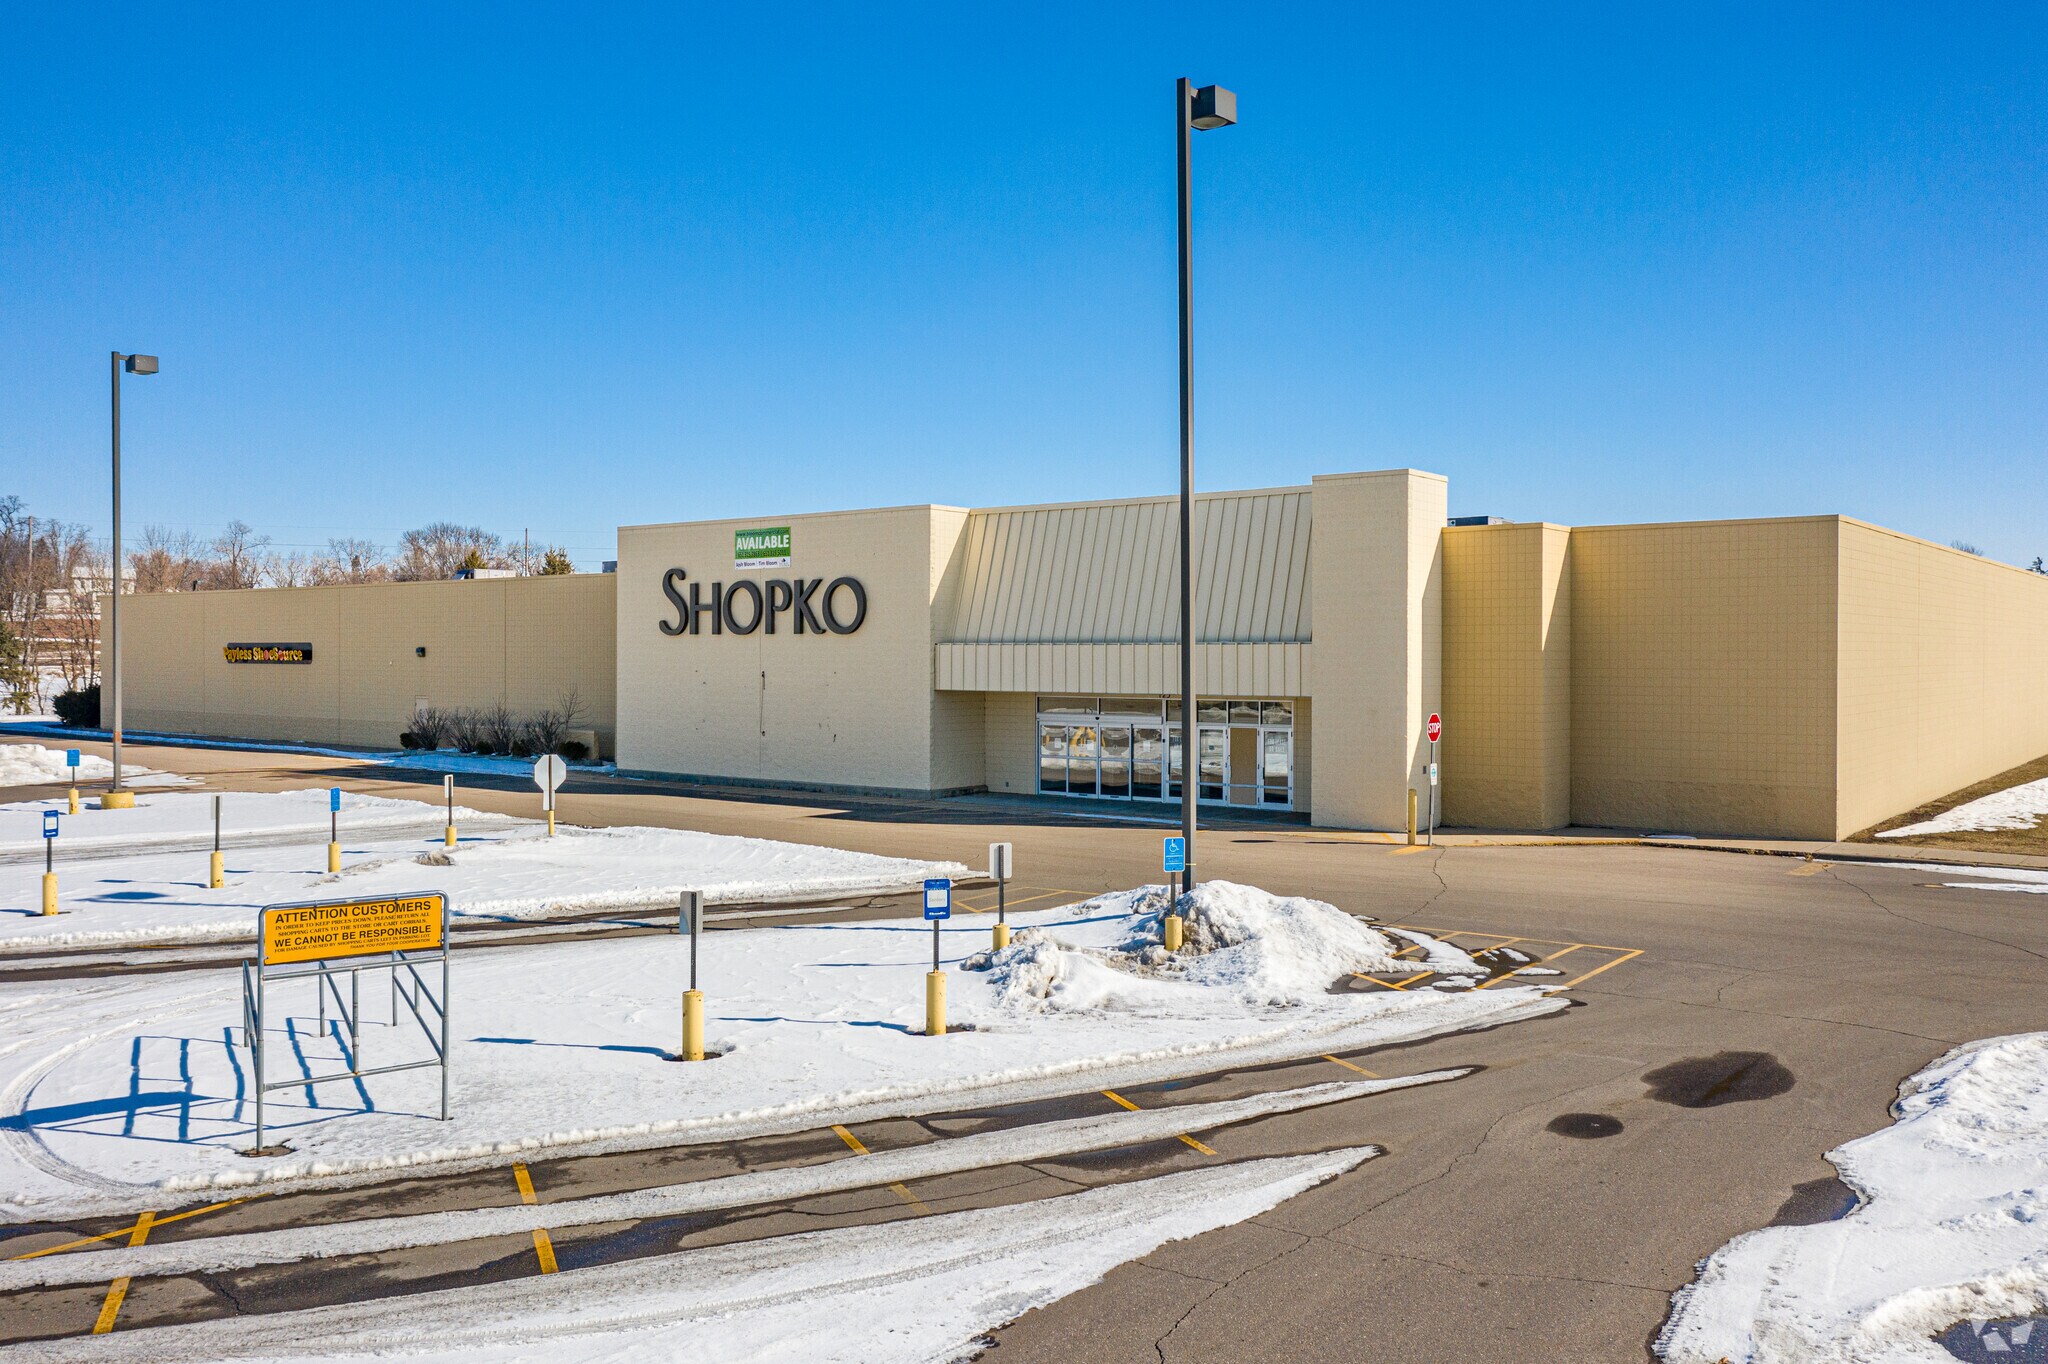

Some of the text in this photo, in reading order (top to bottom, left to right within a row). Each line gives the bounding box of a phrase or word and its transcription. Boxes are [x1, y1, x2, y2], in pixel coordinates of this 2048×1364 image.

[736, 534, 790, 550] AVAILABLE
[659, 568, 867, 635] SHOPKO
[223, 646, 303, 662] Payless ShoeSource
[1428, 722, 1440, 733] STOP
[275, 901, 431, 924] ATTENTION CUSTOMERS
[274, 925, 431, 948] WE CANNOT BE RESPONSIBLE
